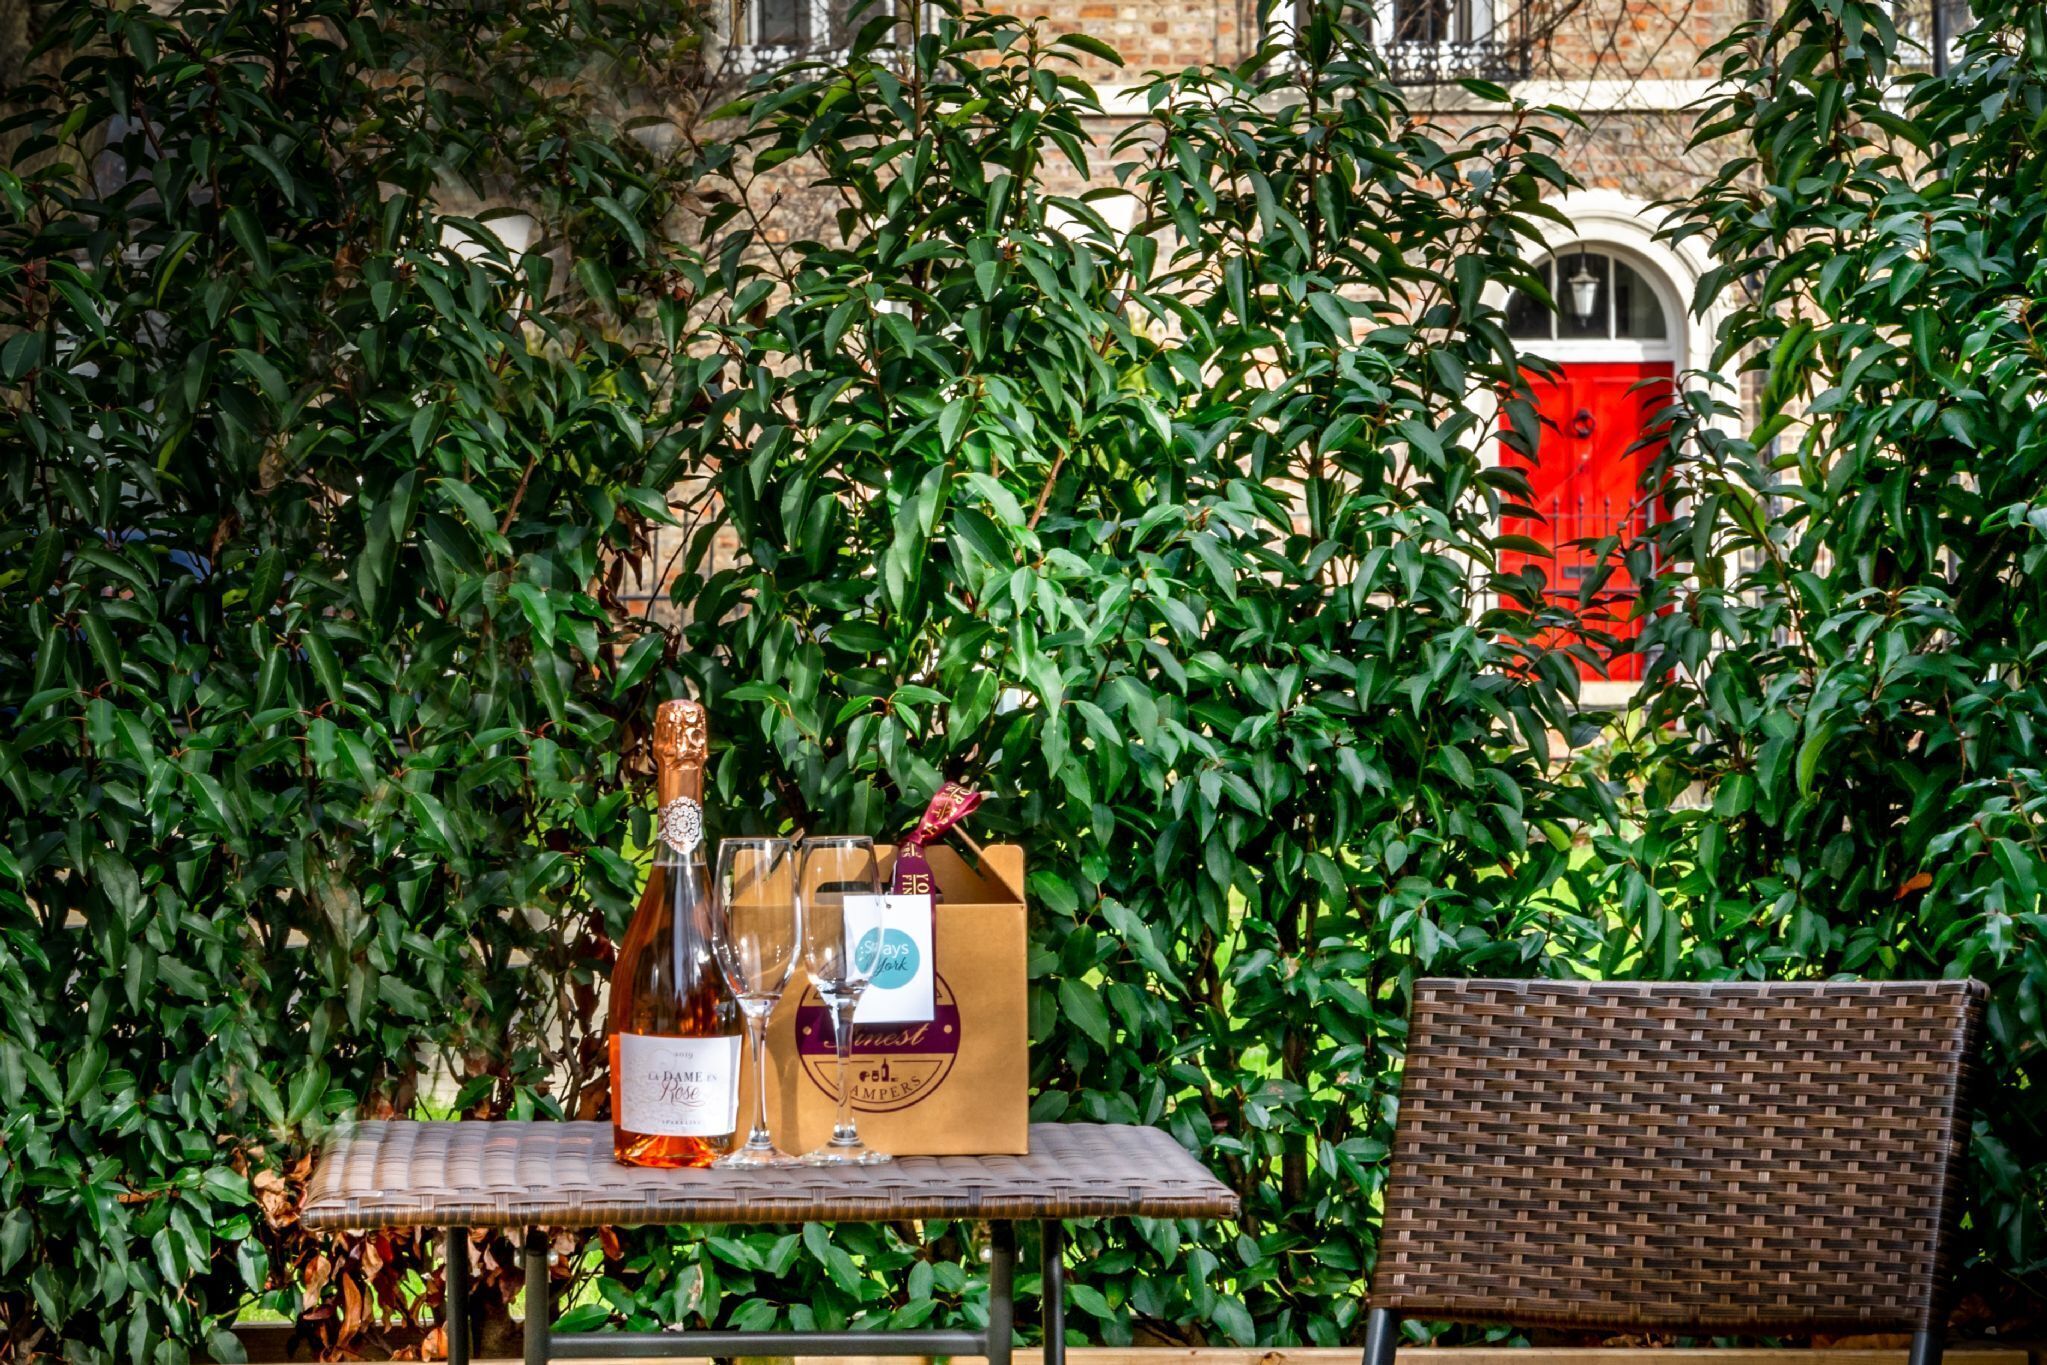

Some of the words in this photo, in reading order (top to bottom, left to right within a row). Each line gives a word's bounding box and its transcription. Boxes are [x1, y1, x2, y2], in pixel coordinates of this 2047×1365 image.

[824, 1022, 930, 1048] inest
[648, 1072, 660, 1081] LA
[663, 1070, 704, 1083] DAME
[849, 1074, 923, 1101] AMPERS
